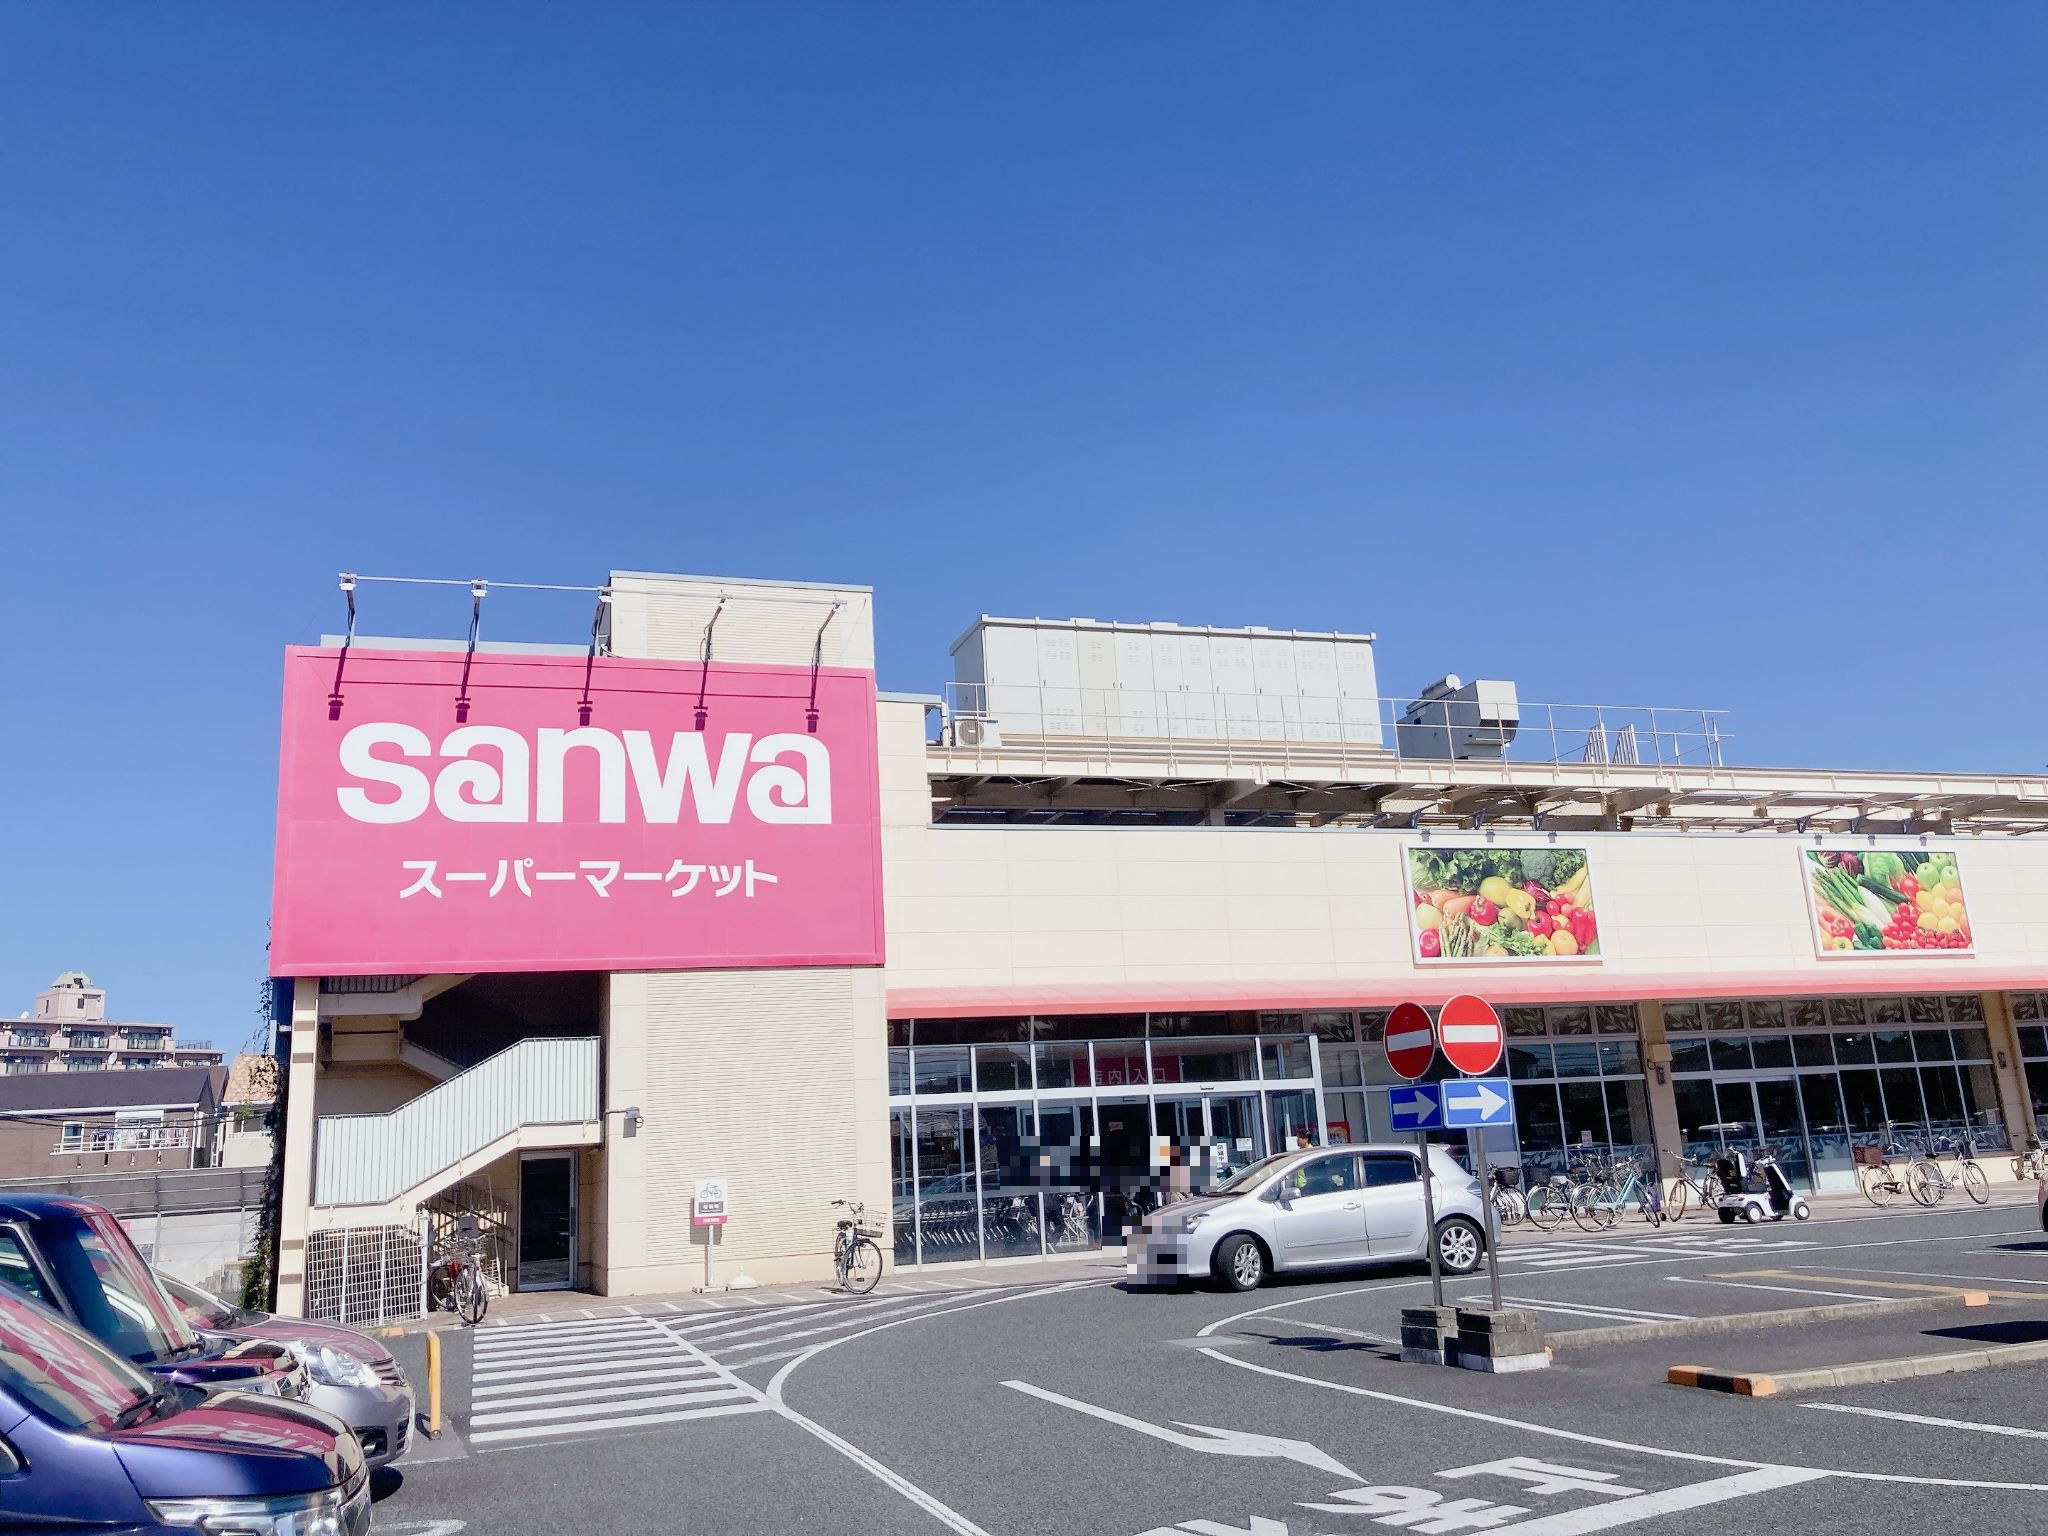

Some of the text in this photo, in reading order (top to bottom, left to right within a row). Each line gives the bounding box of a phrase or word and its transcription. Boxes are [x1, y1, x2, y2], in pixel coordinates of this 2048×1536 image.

[337, 722, 832, 824] sanwa
[400, 857, 778, 899] スーパーマーケット
